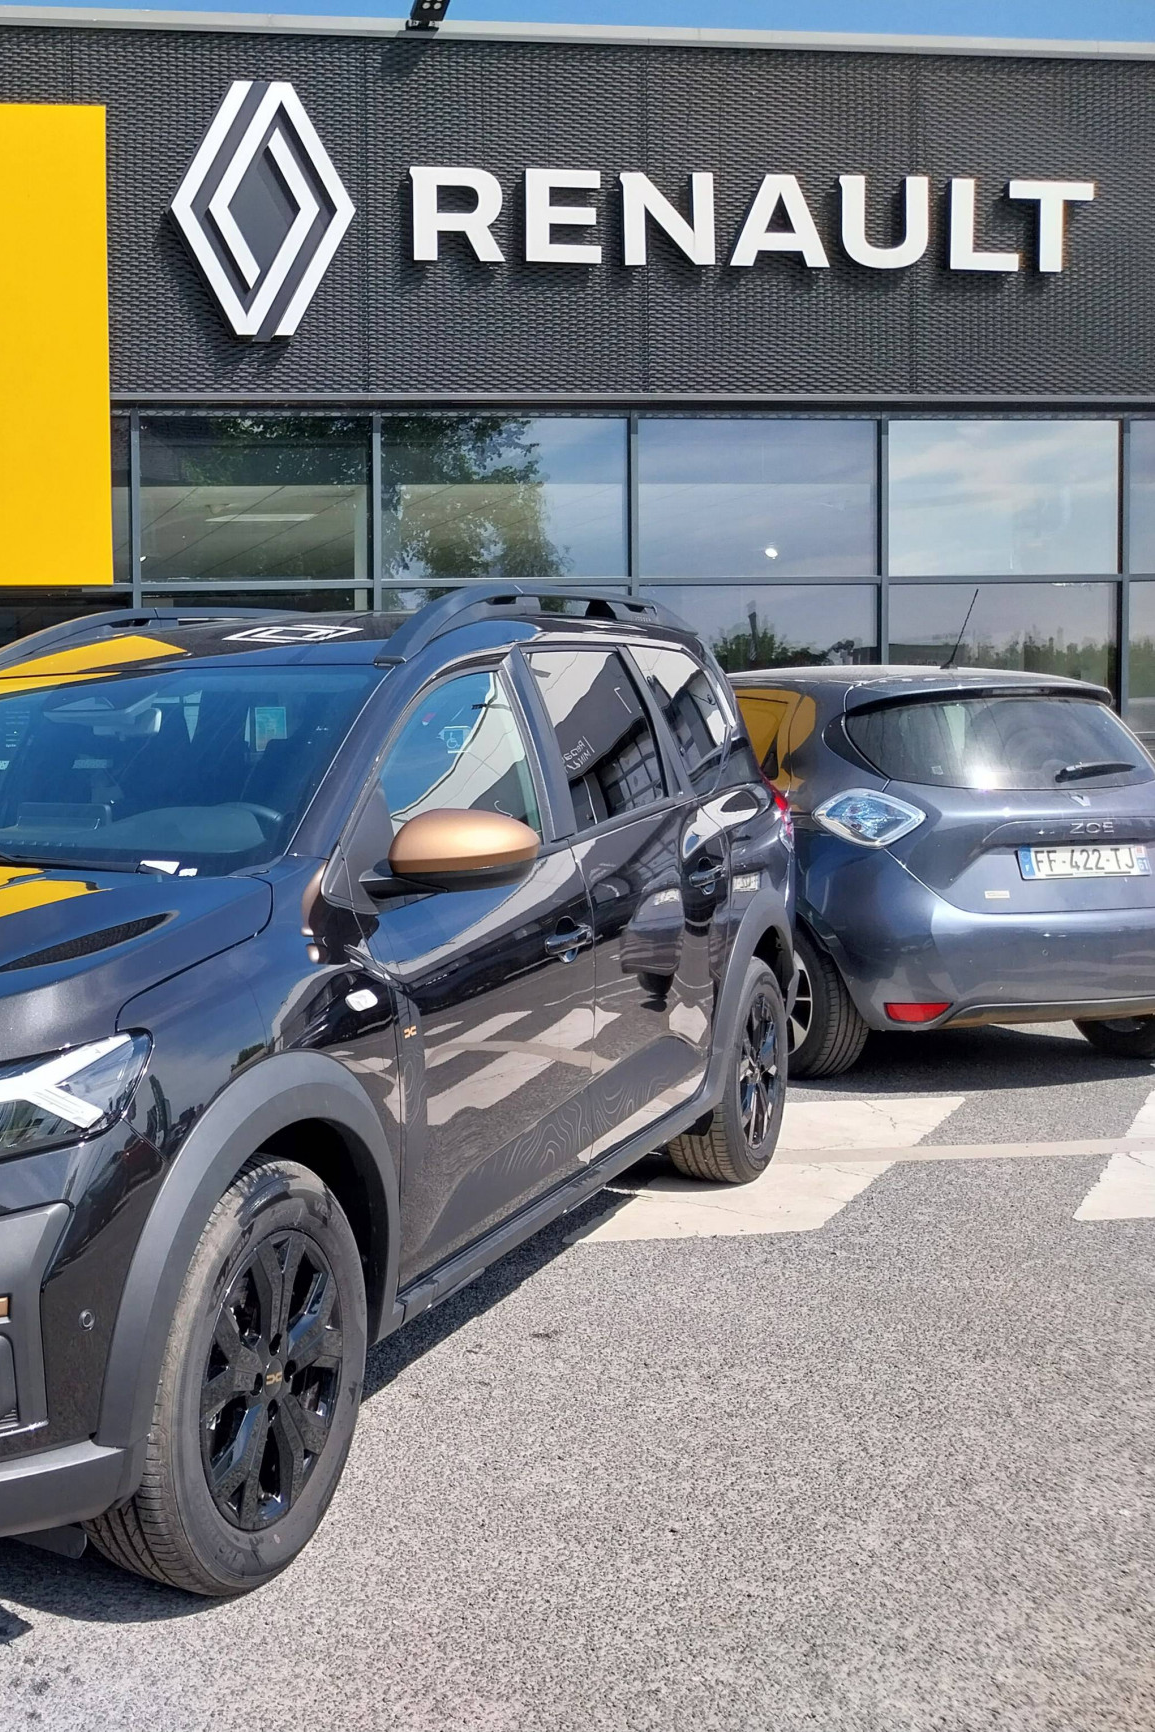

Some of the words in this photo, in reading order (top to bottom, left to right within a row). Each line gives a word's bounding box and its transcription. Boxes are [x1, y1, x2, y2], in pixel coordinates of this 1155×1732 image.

[409, 166, 1095, 273] RENAULT
[1070, 821, 1115, 834] ZOE
[1034, 847, 1135, 872] FF-422-TJ
[1137, 857, 1150, 871] 61
